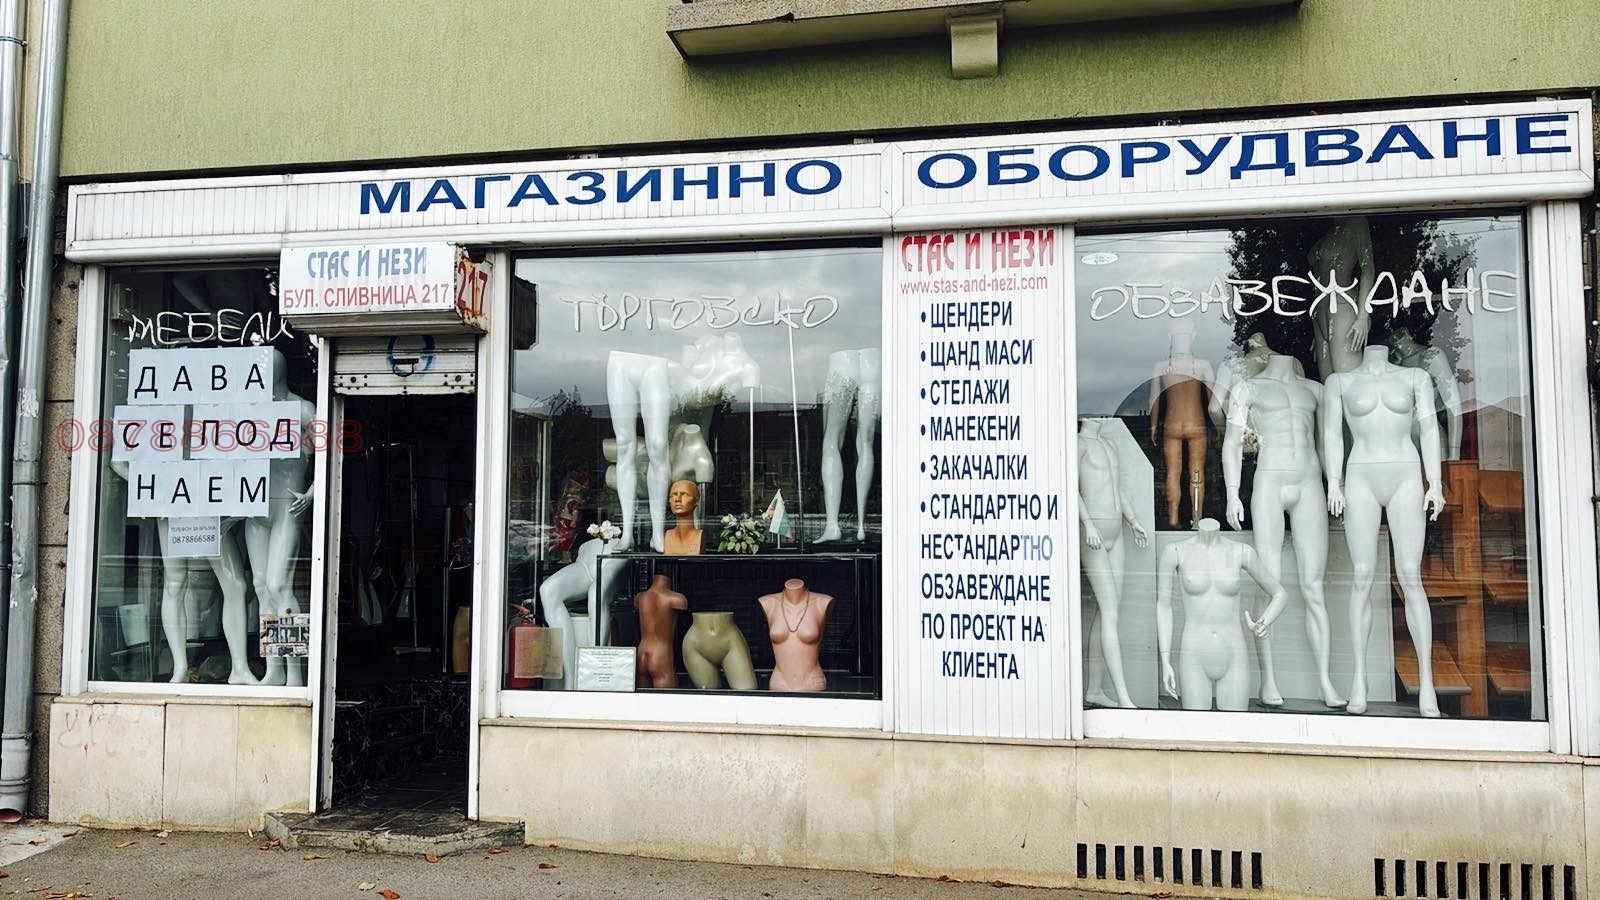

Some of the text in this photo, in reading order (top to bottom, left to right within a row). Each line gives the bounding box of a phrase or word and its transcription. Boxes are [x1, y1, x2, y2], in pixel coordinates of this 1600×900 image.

[360, 114, 1572, 215] МАГАЗИННО ОБОРУДВАНЕ
[307, 247, 427, 280] СТАС И НЕЗИ
[902, 229, 1054, 275] СТАС И НЕЗИ
[283, 283, 449, 309] БУЛ. СЛИВНИЦА 217
[456, 260, 488, 318] 217
[900, 274, 1048, 295] www.stas-and-nezi.com
[1090, 268, 1520, 321] ОБЗАВЕЖДАНЕ
[126, 309, 294, 346] МЕБЕЛИ
[931, 301, 1012, 332] ЩЕНДЕРИ
[931, 339, 1033, 371] ЩАНД МАСИ
[134, 364, 265, 399] ДАВА
[930, 379, 1010, 405] СТЕЛАЖИ
[122, 418, 294, 452] СЕ ПОД
[930, 415, 1020, 441] МАНЕКЕНИ
[930, 454, 1027, 480] ЗАКАЧАЛКИ
[136, 474, 267, 504] НАЕМ
[930, 493, 1058, 525] СТАНДАРТНО И
[172, 534, 216, 544] 0878866588
[921, 533, 1053, 565] НЕСТАНДАРТНО
[921, 573, 1051, 606] ОБЗАВЕЖДАНЕ
[922, 613, 1045, 642] ПО ПРОЕКТ НА
[942, 651, 1019, 680] КЛИЕНТА
